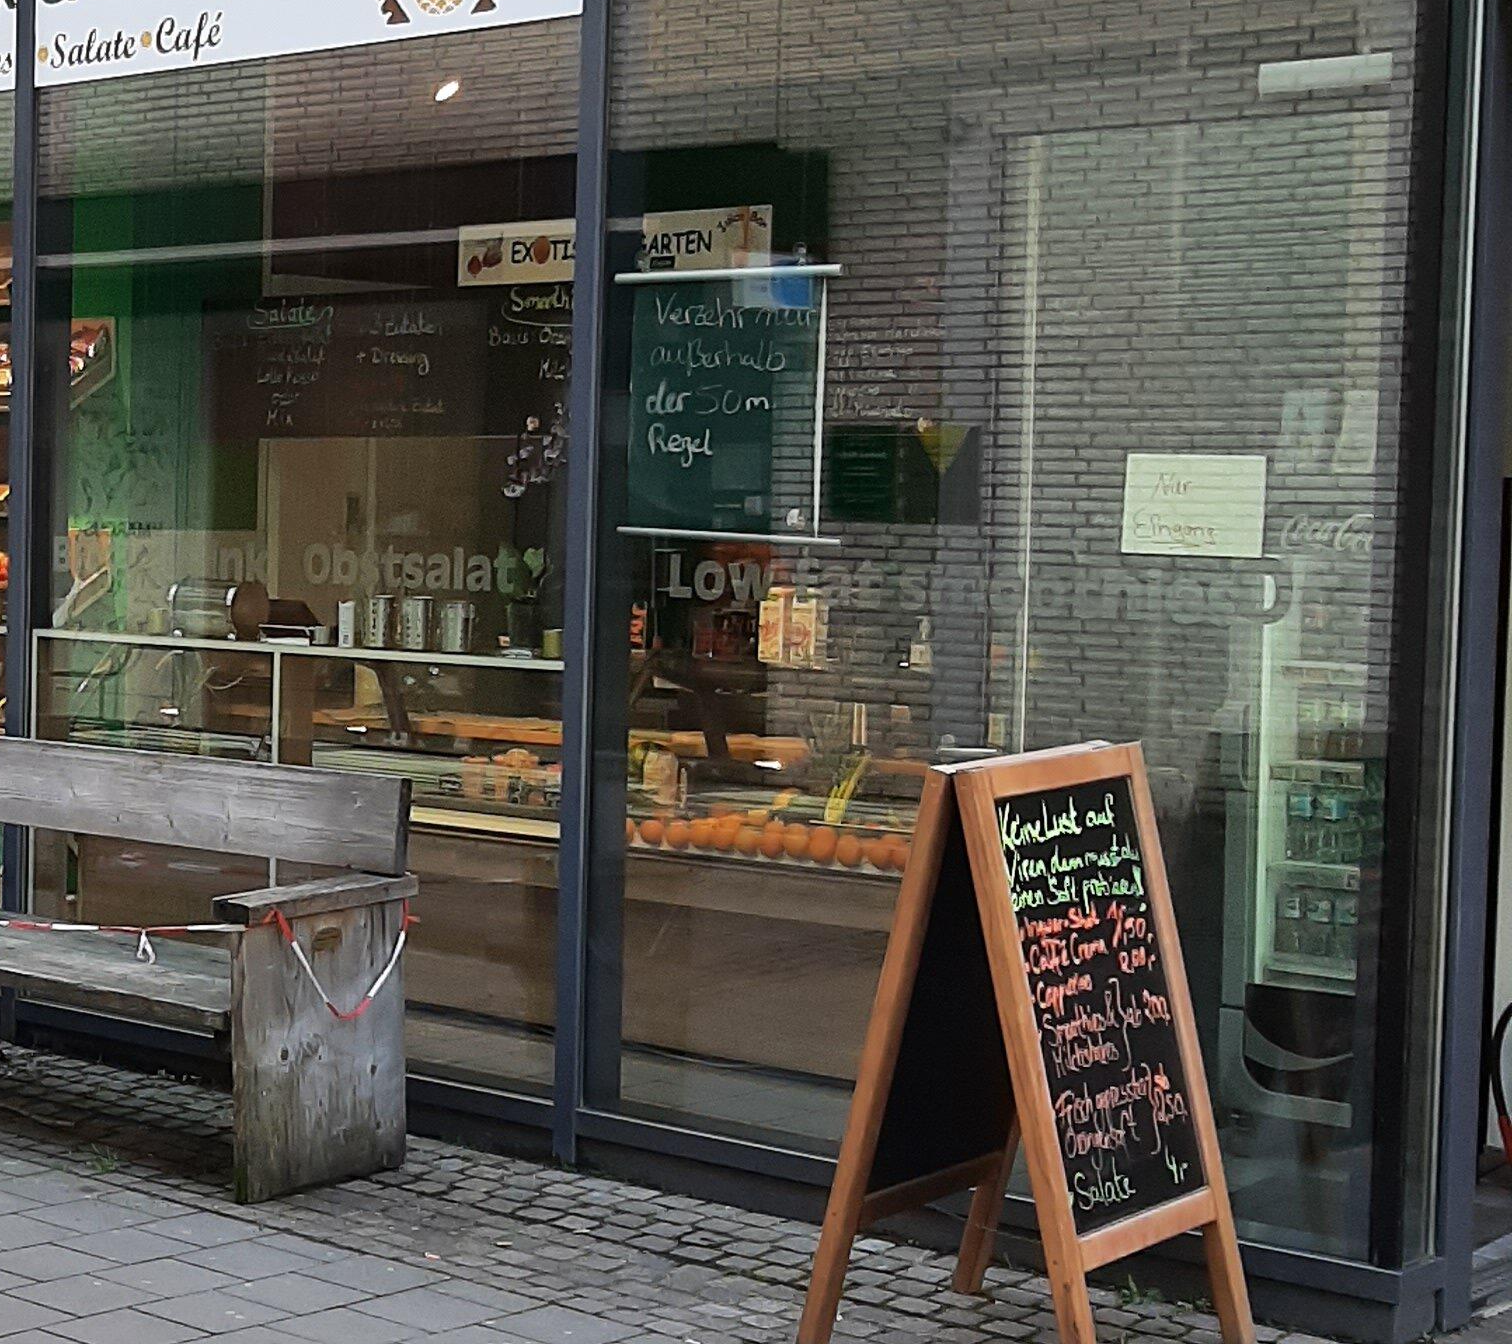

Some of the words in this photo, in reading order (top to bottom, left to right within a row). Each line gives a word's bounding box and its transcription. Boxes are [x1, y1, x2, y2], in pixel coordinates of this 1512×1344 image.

[50, 29, 137, 69] Salate
[155, 11, 223, 62] Café
[656, 292, 748, 329] Verzehr
[650, 337, 786, 377] außerhalb
[645, 379, 691, 415] der
[647, 422, 714, 468] Regel
[1085, 793, 1116, 827] auf
[1073, 1156, 1137, 1211] Salate
